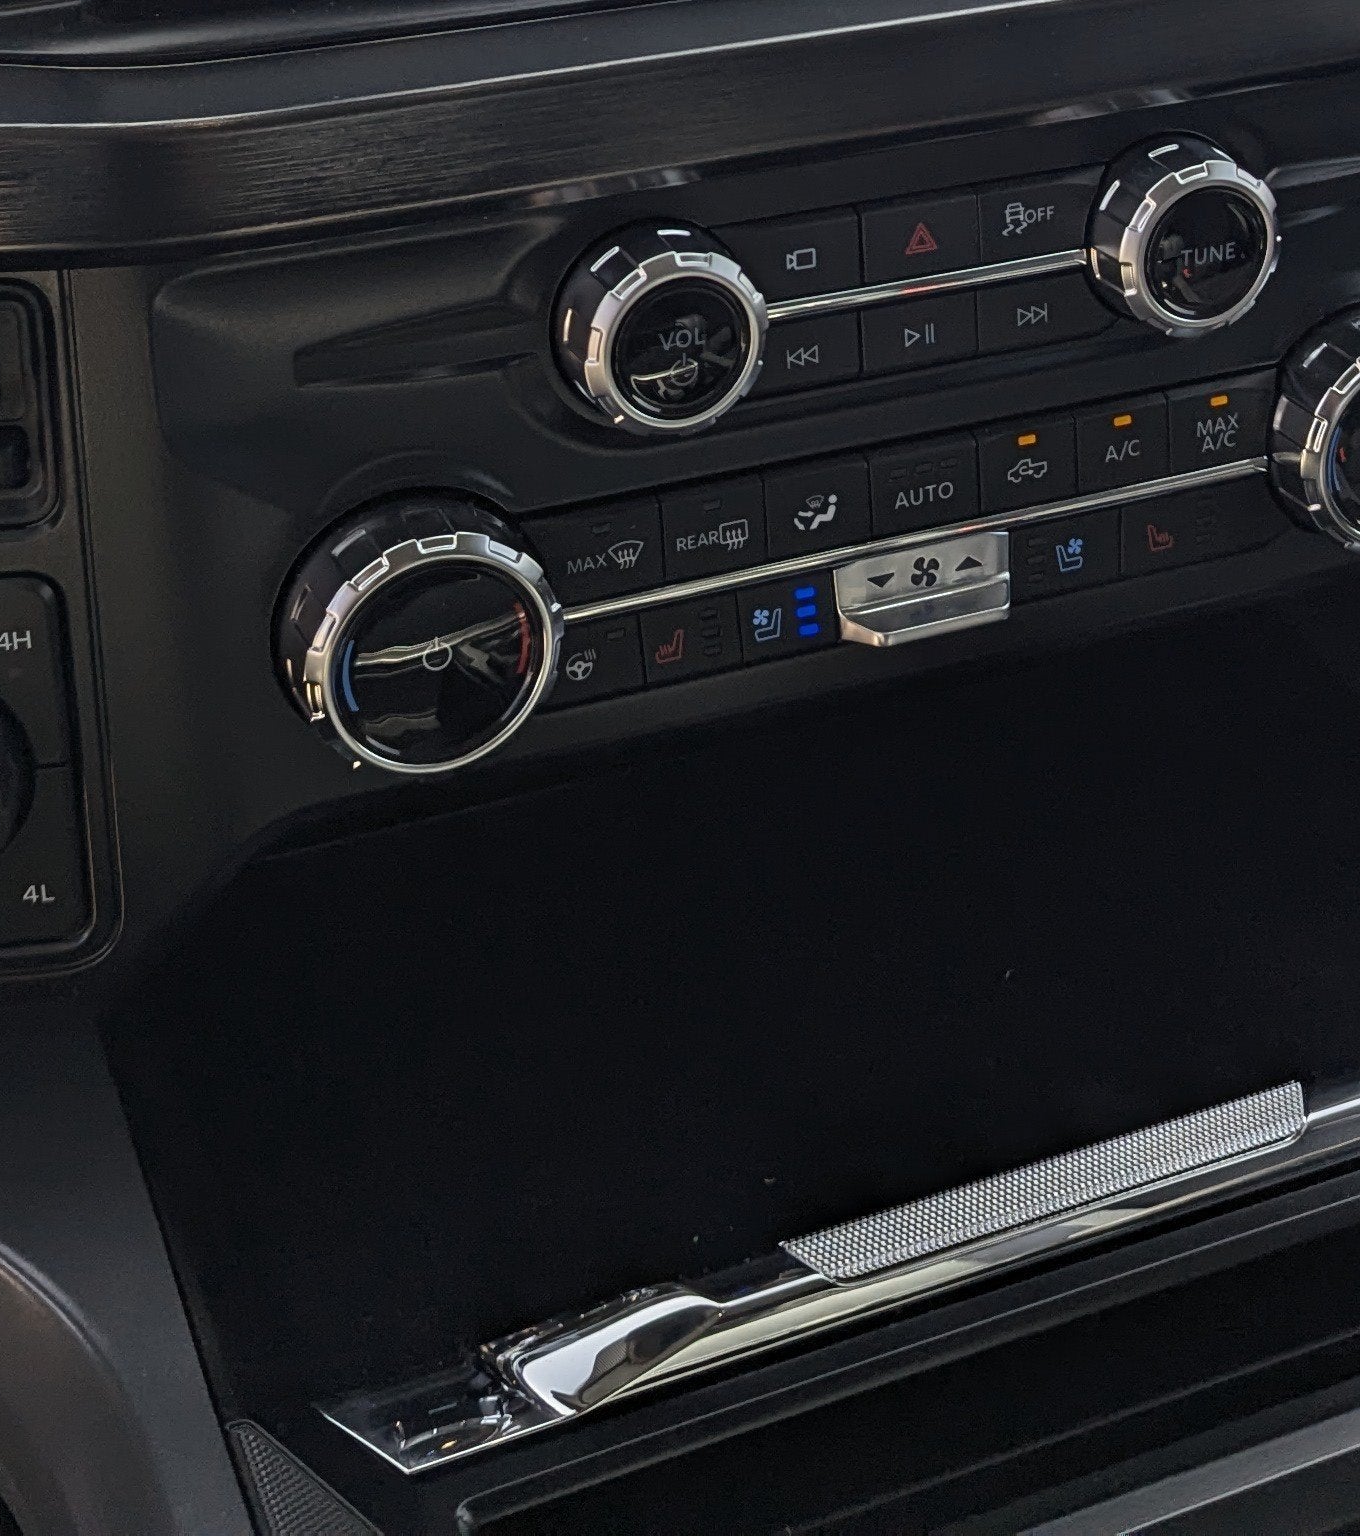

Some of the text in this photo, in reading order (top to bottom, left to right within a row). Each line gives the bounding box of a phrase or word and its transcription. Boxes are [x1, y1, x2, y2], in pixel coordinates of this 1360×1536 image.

[1025, 205, 1055, 226] OFF
[1180, 241, 1237, 267] TUNE
[658, 327, 708, 351] VOL
[1196, 412, 1240, 440] MAX
[1105, 438, 1141, 464] A/C
[1200, 430, 1238, 454] A/C
[894, 480, 955, 510] AUTO
[676, 529, 719, 553] REAR
[566, 552, 608, 576] MAX
[22, 883, 56, 904] 4L
